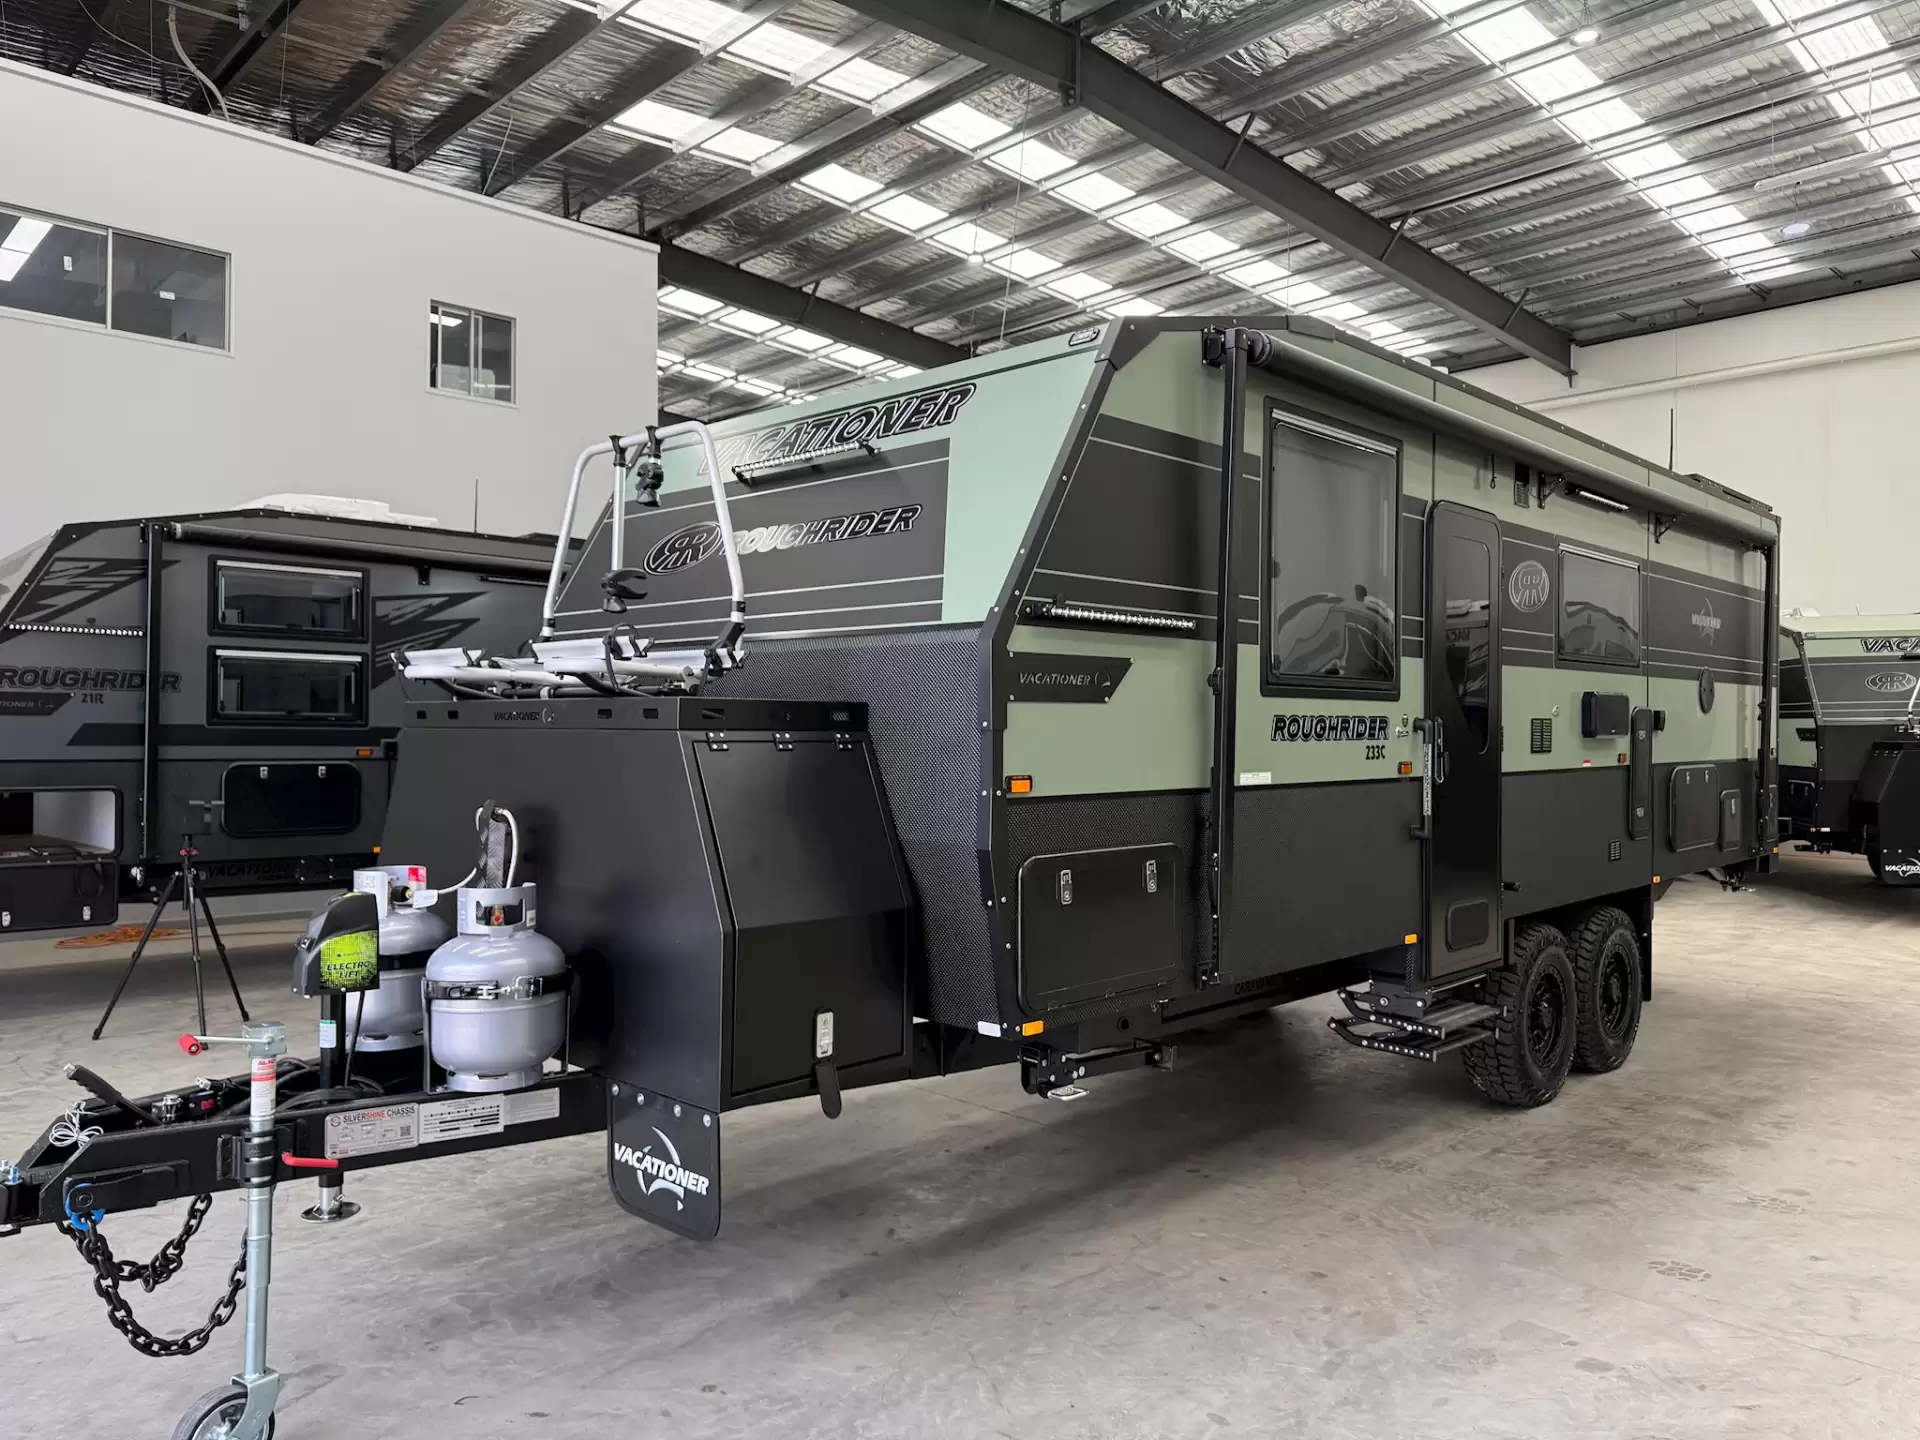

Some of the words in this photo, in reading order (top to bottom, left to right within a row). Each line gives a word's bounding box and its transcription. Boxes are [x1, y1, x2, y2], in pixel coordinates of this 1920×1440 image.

[0, 665, 181, 692] ROUGHRIDR
[1019, 672, 1090, 686] VACATIONER
[81, 693, 104, 704] 21R
[1271, 715, 1390, 741] ROUGHRIDER
[1365, 745, 1386, 760] 233C
[343, 1110, 387, 1123] SILVERSHINE
[387, 1105, 416, 1117] CHASSIS
[614, 1142, 710, 1196] VACATIONER
